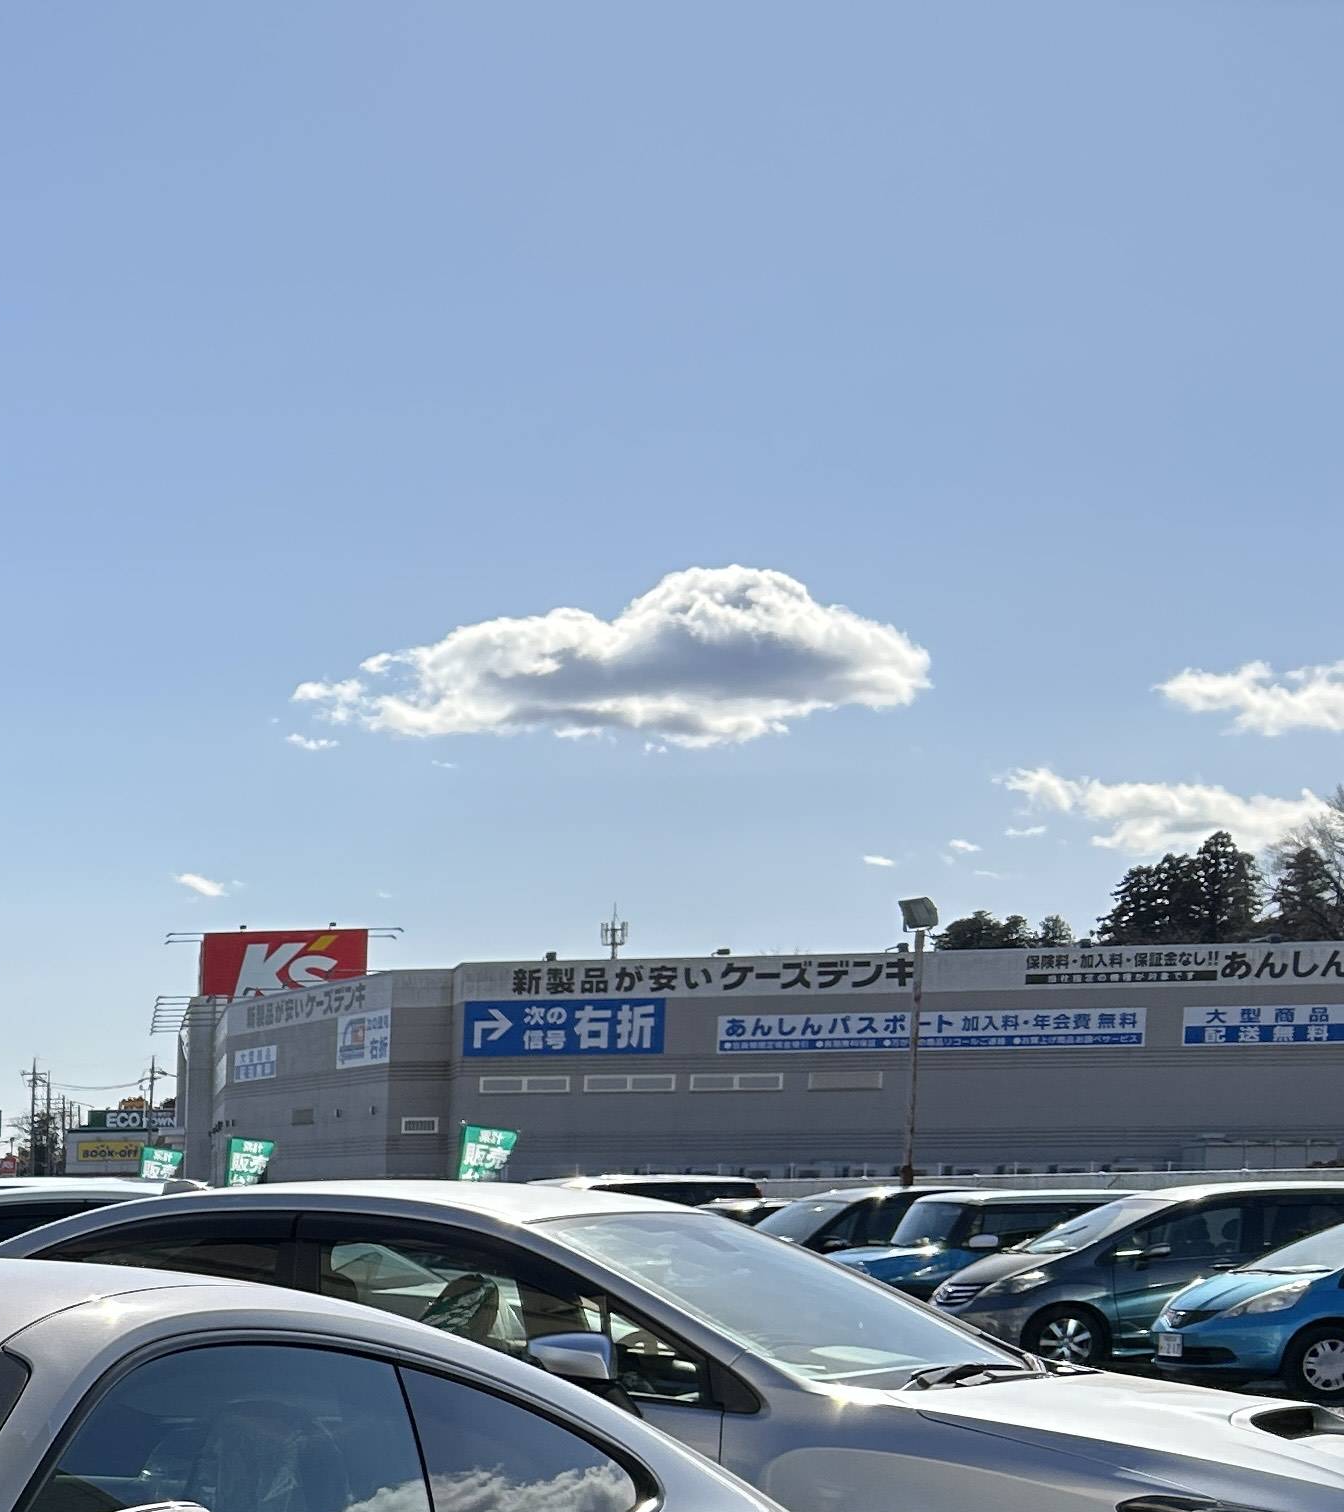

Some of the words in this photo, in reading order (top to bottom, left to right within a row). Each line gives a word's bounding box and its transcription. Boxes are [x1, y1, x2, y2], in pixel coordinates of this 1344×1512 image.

[522, 1005, 568, 1026] 次の
[1097, 1012, 1138, 1030] 無料
[1205, 1006, 1330, 1025] 大型商品
[574, 1003, 657, 1050] 右折
[1203, 1025, 1330, 1043] 配送無料
[522, 1028, 568, 1051] 信号
[106, 1112, 141, 1128] ECO
